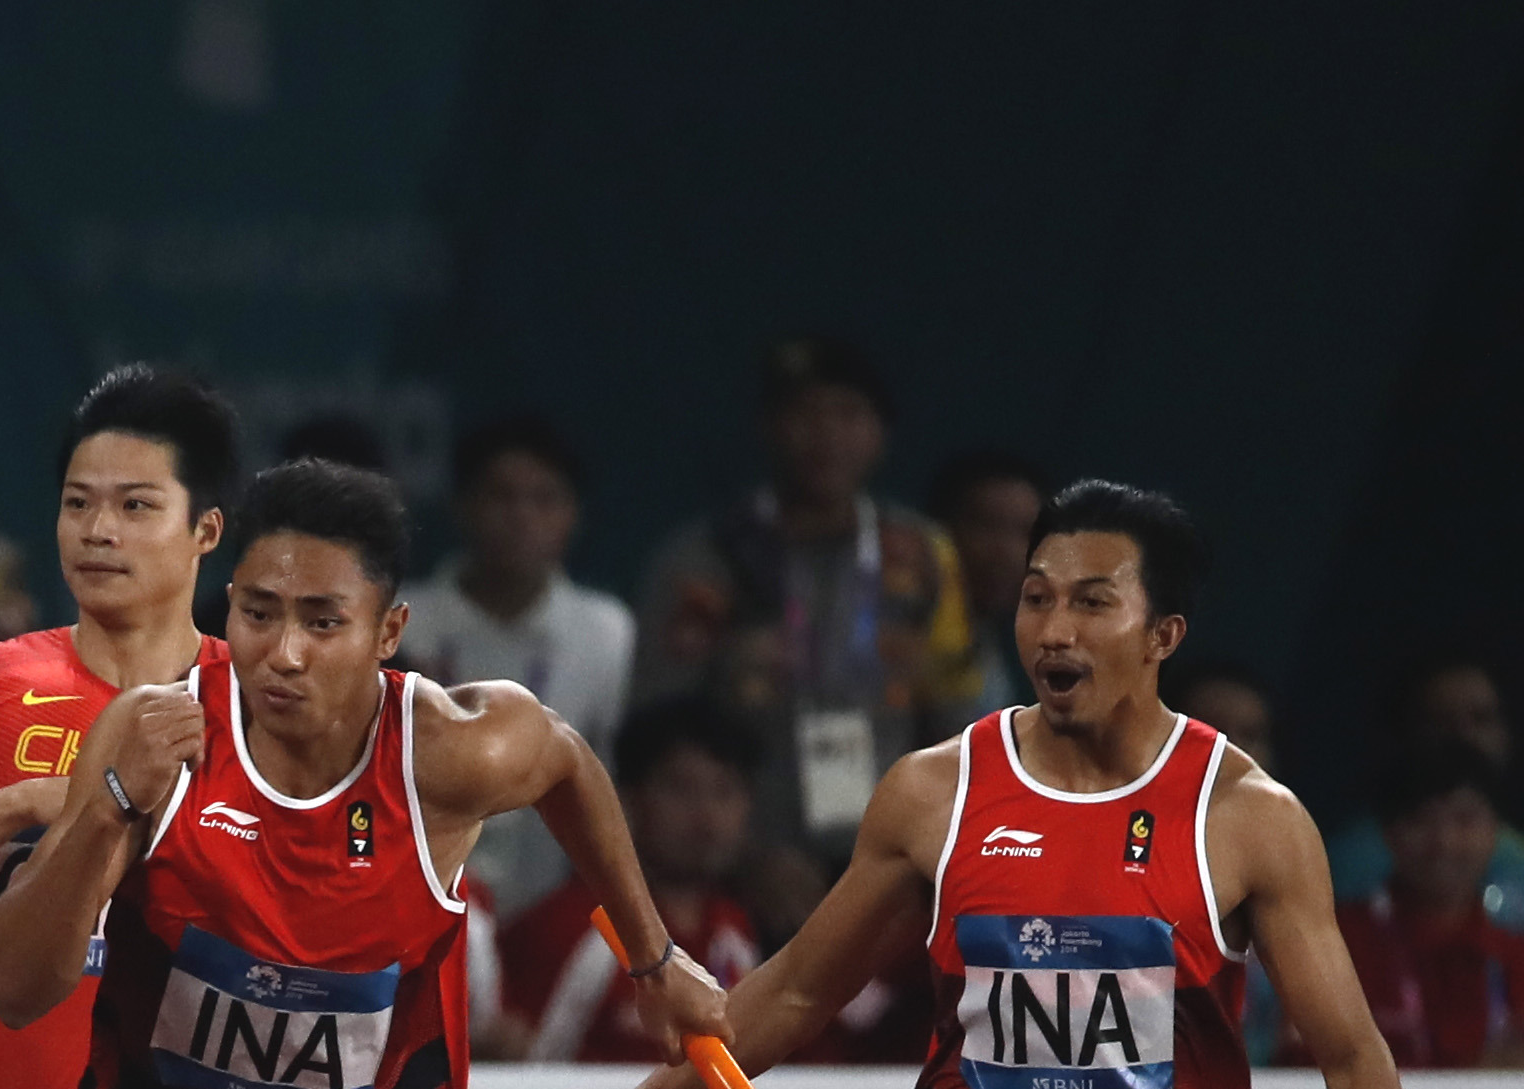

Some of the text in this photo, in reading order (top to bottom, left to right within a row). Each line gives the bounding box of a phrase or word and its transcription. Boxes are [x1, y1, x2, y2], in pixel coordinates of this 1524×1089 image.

[199, 816, 259, 841] LI-NING
[981, 846, 1043, 858] LI-NING
[987, 971, 1141, 1067] INA
